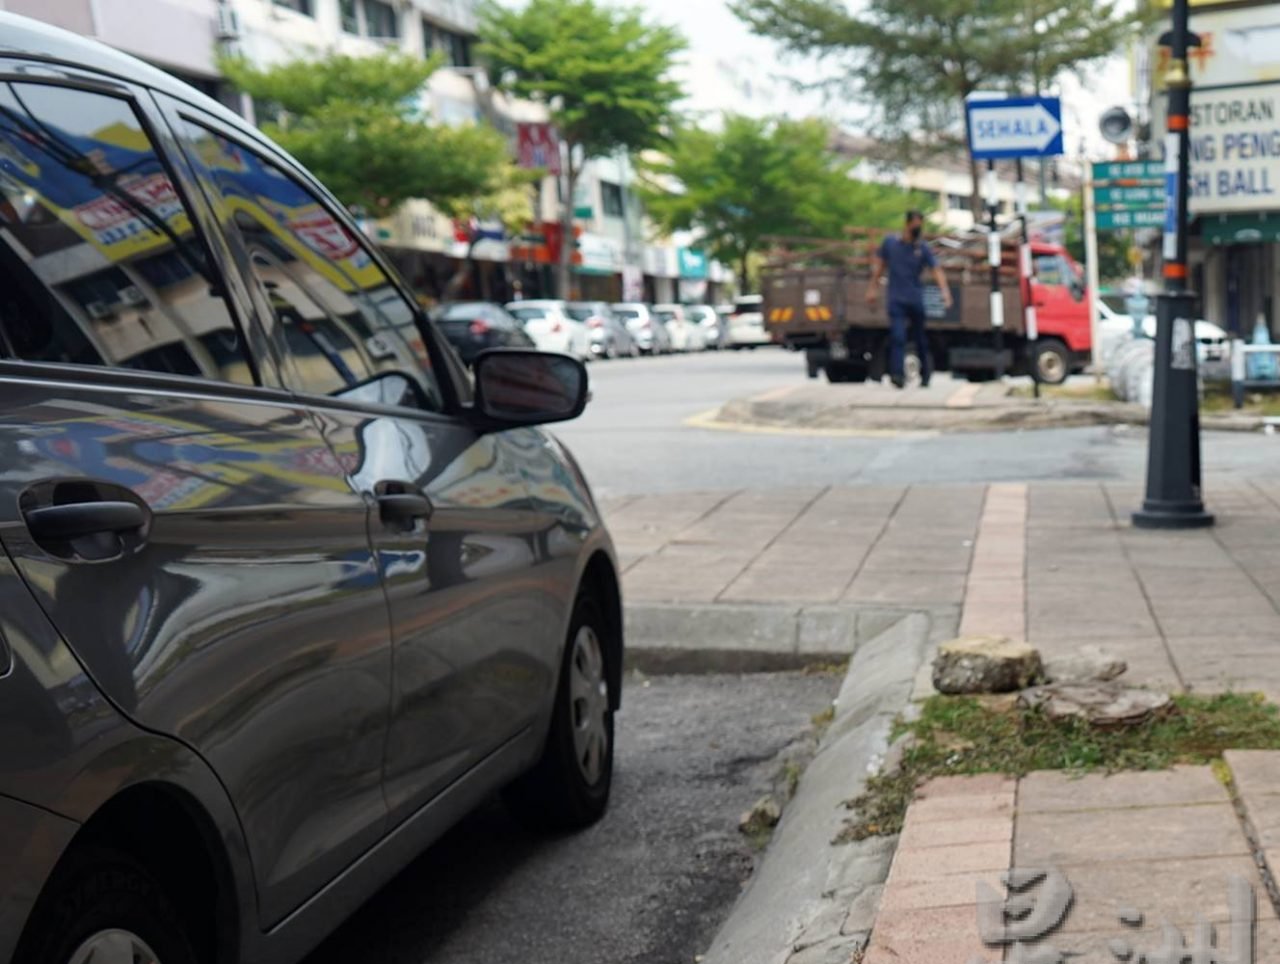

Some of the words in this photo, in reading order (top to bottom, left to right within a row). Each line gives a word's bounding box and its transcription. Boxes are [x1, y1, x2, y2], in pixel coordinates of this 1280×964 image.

[1189, 99, 1274, 128] STORAN
[976, 119, 1049, 139] SEHALA
[1217, 167, 1275, 197] BALL
